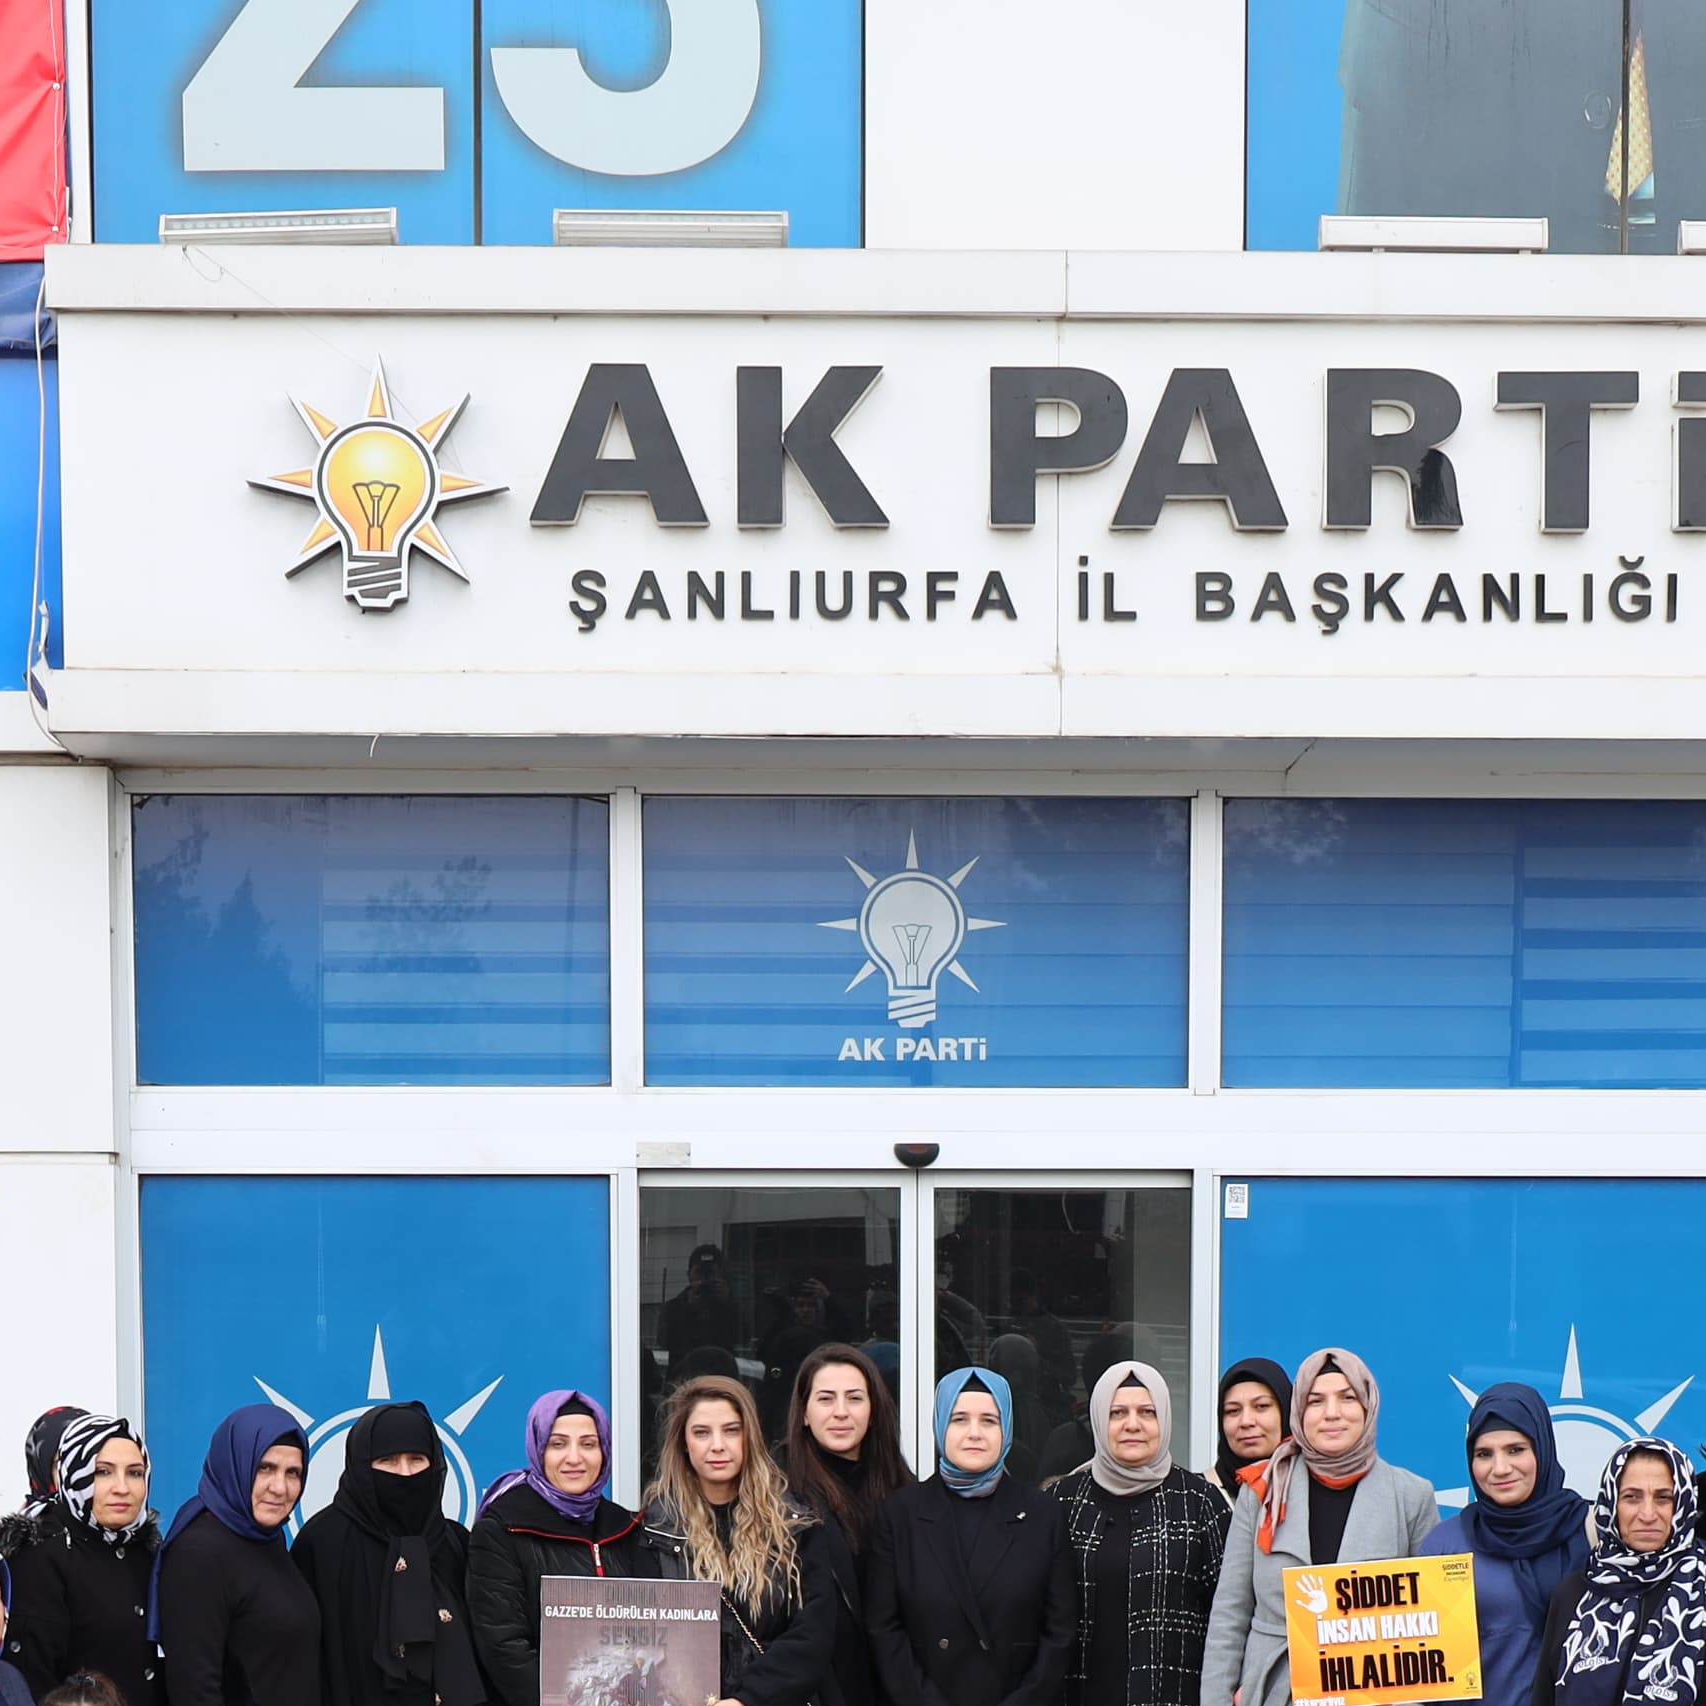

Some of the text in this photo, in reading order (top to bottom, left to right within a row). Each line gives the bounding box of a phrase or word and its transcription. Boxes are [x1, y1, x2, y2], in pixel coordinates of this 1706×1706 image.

[530, 363, 889, 529] AK
[569, 556, 1678, 635] ŞANLIURFA İL BAŞKANLIĞI
[838, 1038, 885, 1061] AK
[545, 1604, 719, 1621] GAZZE'DE ÖLDÜRÜLEN KADINLARA
[1335, 1569, 1420, 1615] ŞİDDET
[1317, 1611, 1439, 1644] İNSAN HAKKI
[1319, 1643, 1454, 1692] İHLALİDİR.
